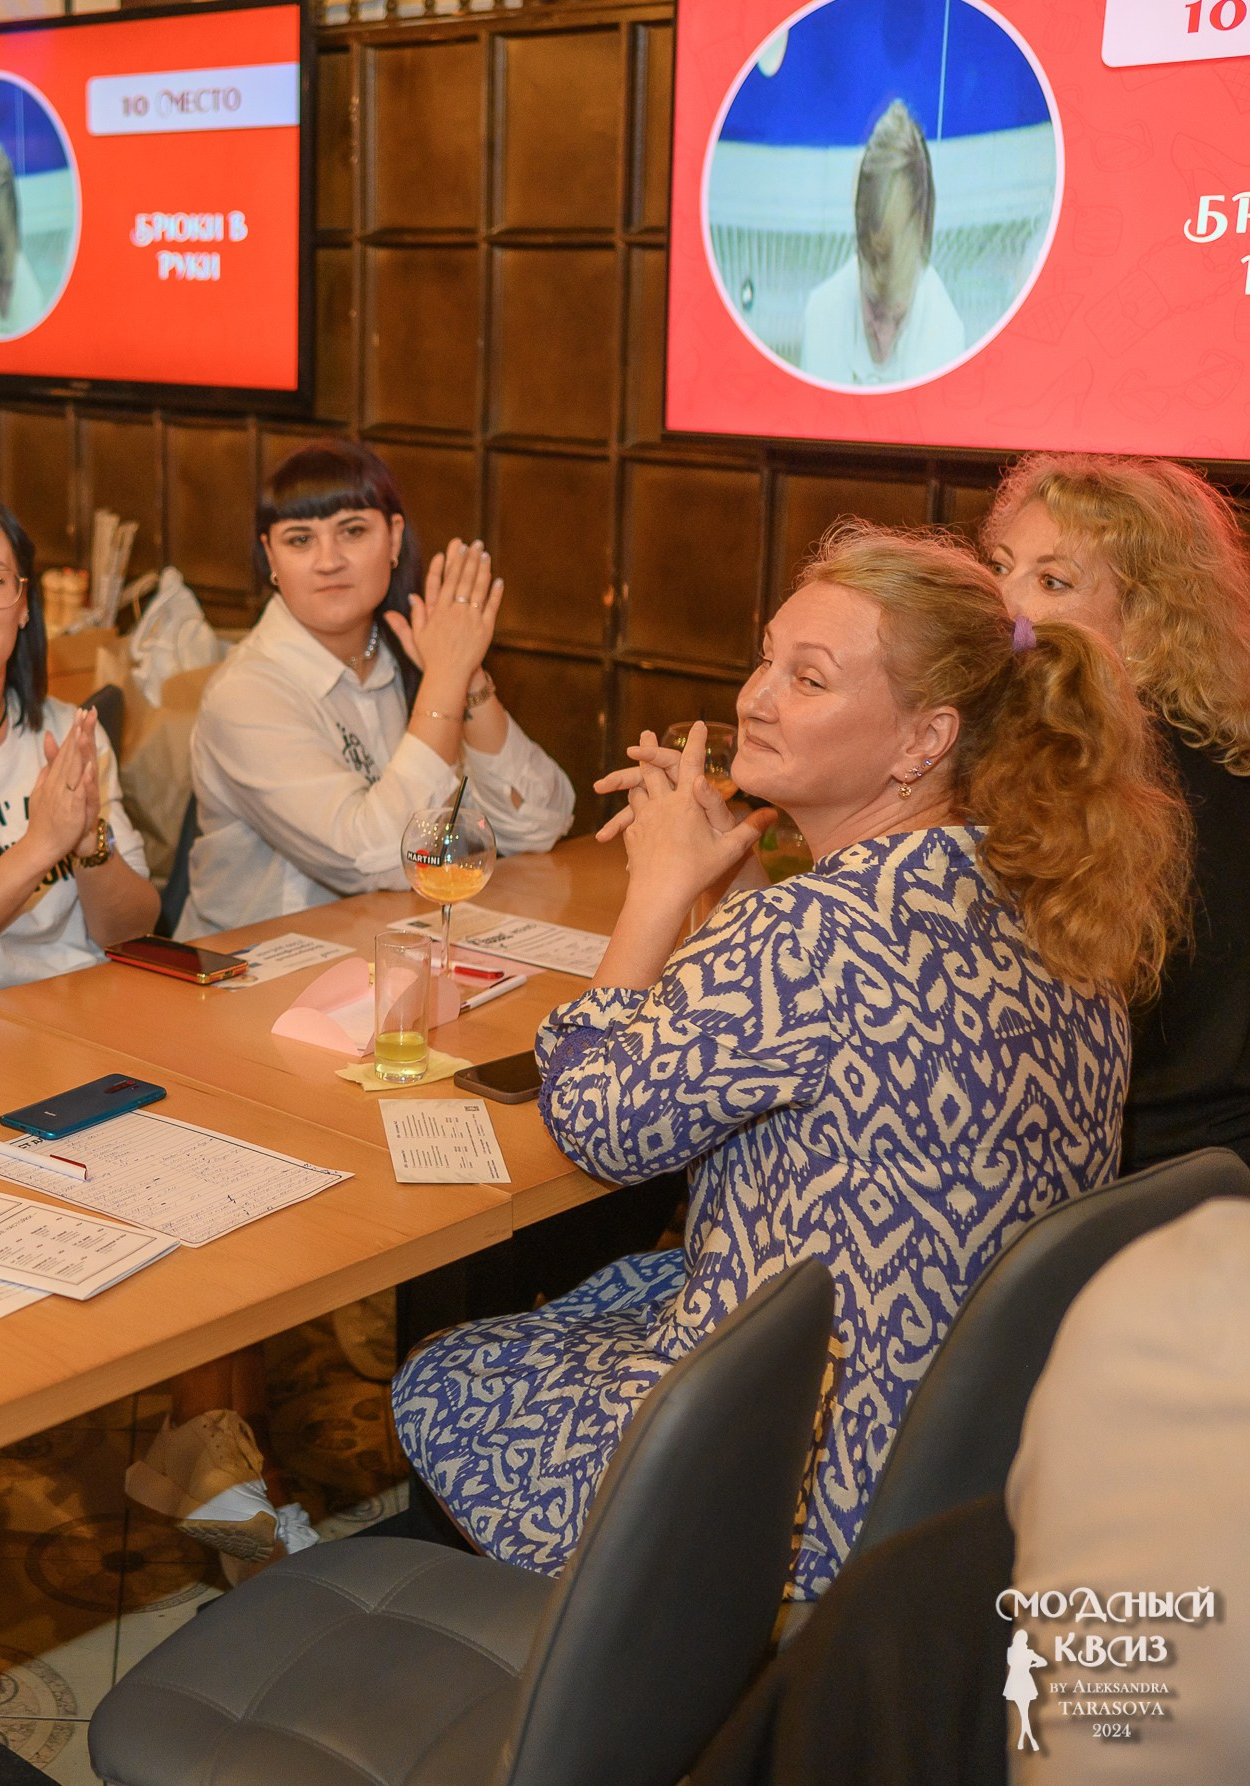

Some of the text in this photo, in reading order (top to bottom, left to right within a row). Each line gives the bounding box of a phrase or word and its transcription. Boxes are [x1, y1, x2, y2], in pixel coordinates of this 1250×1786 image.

[1185, 0, 1248, 33] 10
[121, 87, 243, 118] 10 МЕСТО
[130, 210, 249, 247] БРЮКИ В
[155, 251, 221, 281] РУКИ
[407, 851, 441, 866] MARTINI
